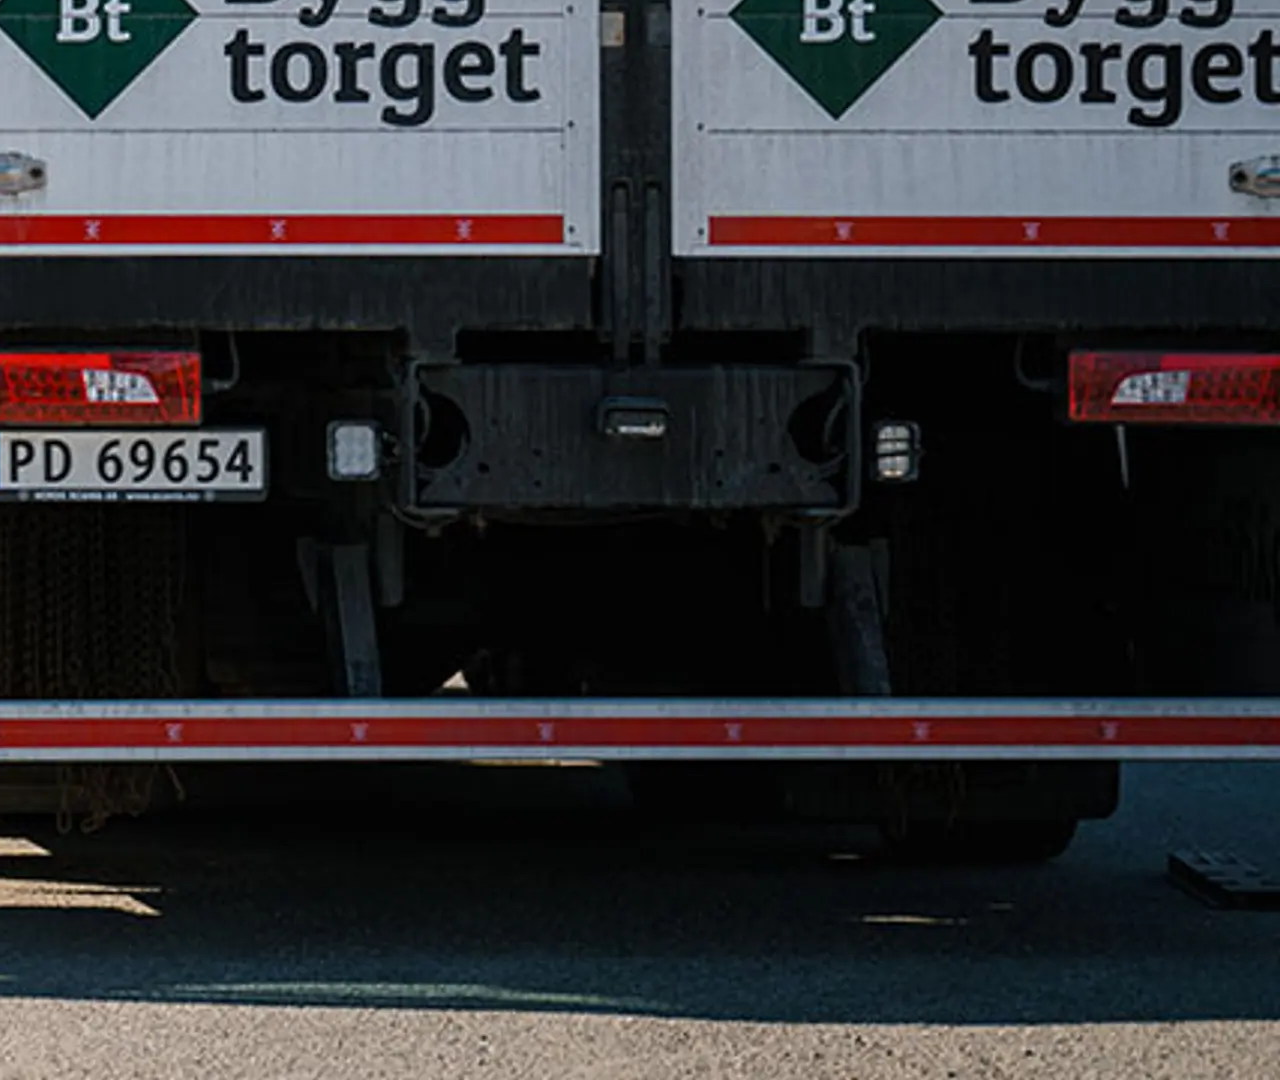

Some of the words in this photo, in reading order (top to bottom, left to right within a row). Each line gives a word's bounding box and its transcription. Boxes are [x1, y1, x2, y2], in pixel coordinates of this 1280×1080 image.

[224, 29, 541, 126] torget
[968, 29, 1280, 126] torget
[9, 439, 72, 483] PD
[97, 439, 253, 483] 69654
